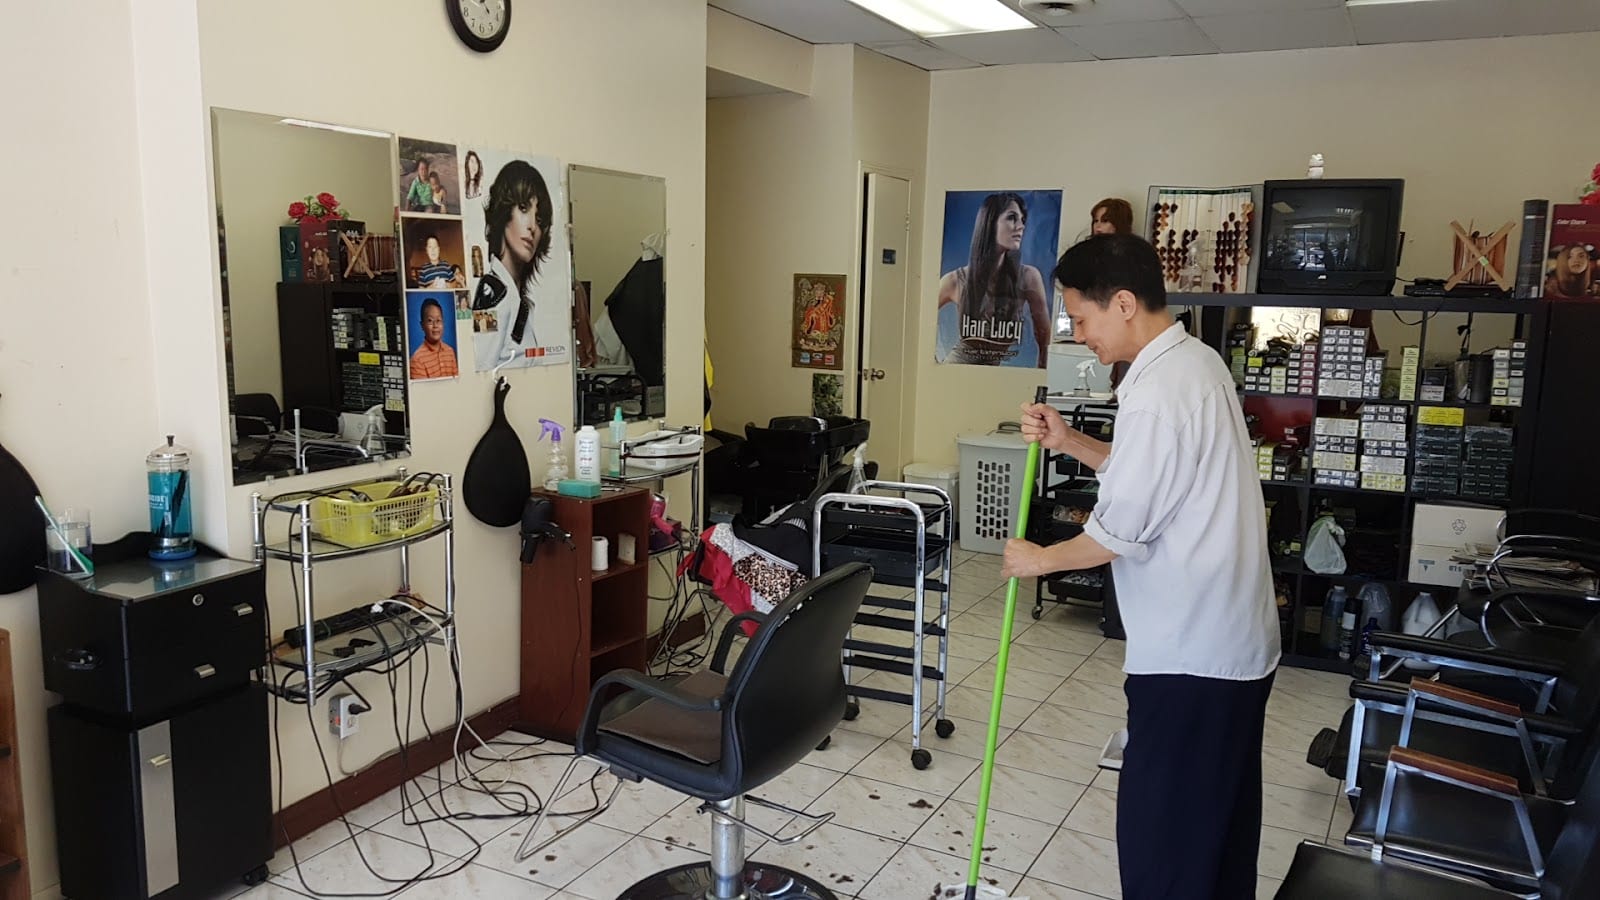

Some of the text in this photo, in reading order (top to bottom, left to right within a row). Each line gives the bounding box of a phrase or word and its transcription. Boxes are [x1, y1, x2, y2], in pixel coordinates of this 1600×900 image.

[463, 7, 469, 17] 8
[471, 18, 476, 28] 7
[488, 22, 494, 32] 5
[479, 23, 485, 34] 6
[962, 314, 1022, 345] Hair Lucy
